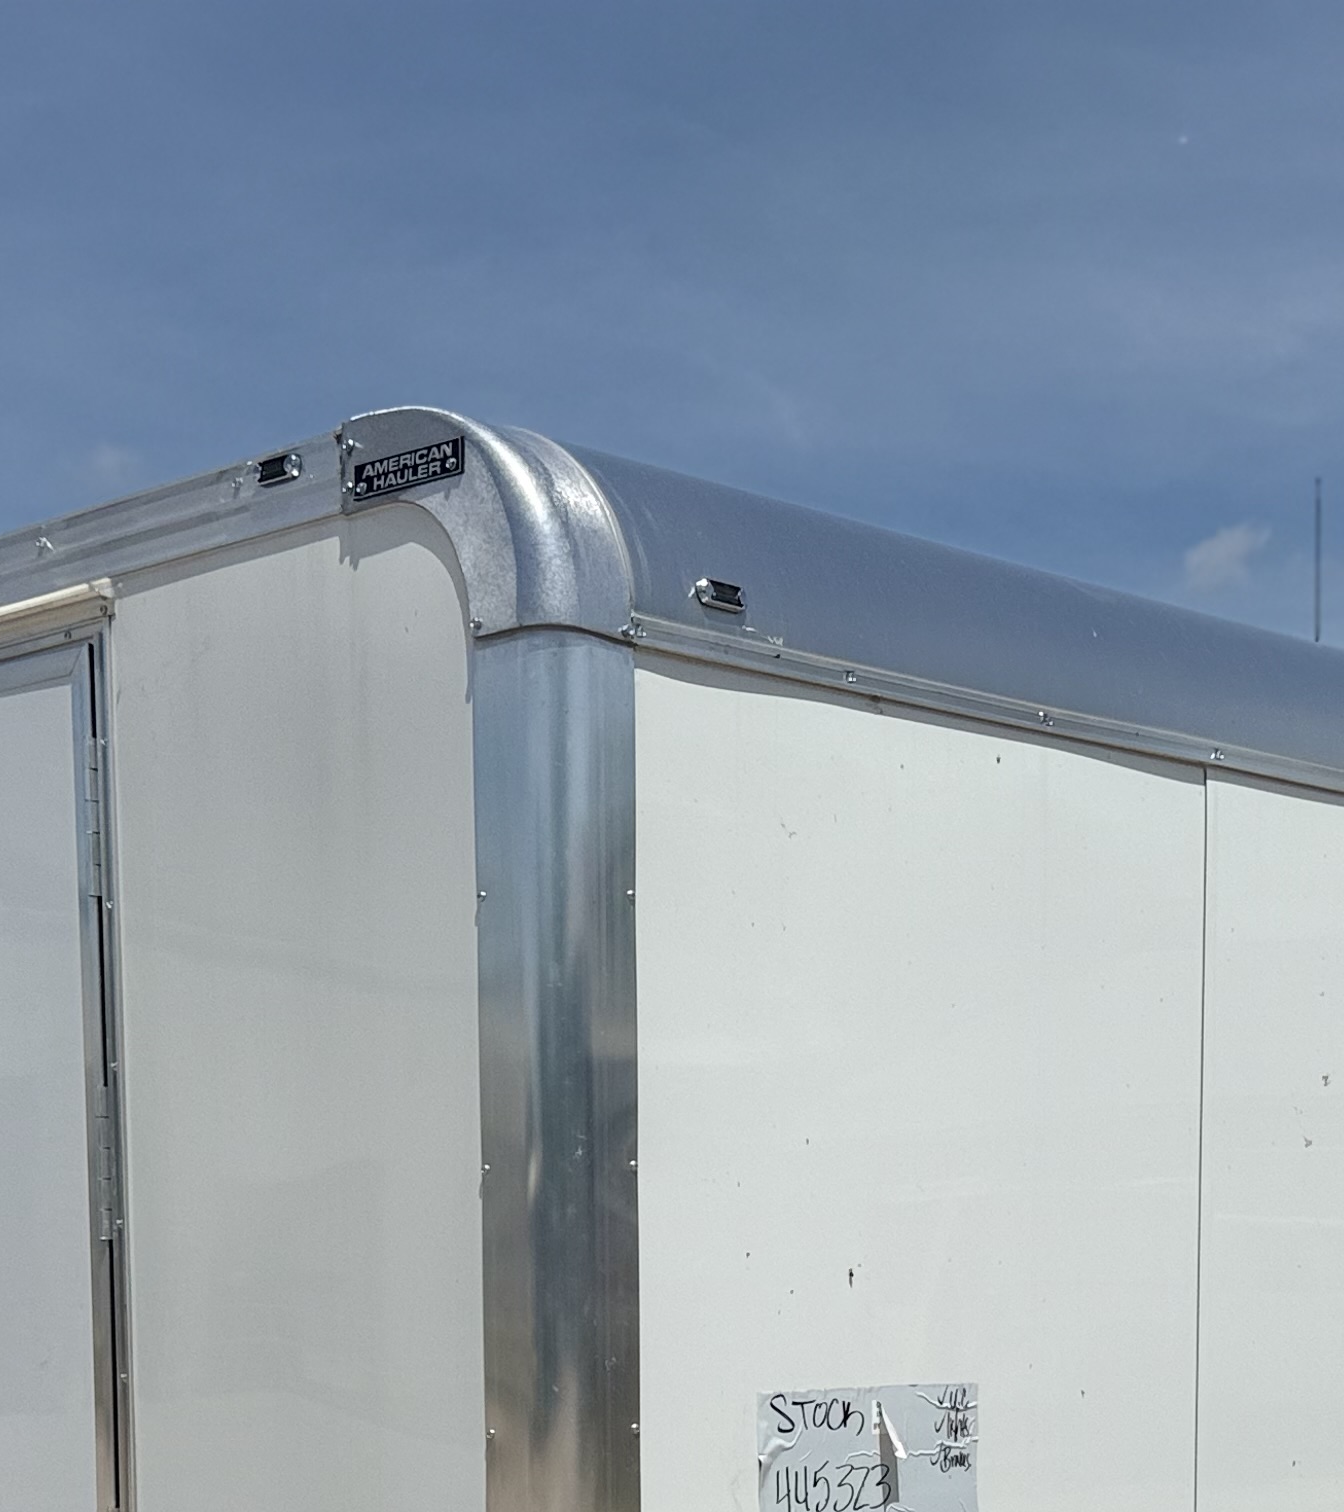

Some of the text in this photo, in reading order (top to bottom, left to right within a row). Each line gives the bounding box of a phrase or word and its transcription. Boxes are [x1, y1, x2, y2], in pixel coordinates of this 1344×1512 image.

[362, 442, 453, 479] AMERICAN
[373, 461, 441, 490] HAULER
[770, 1394, 864, 1436] STOCK
